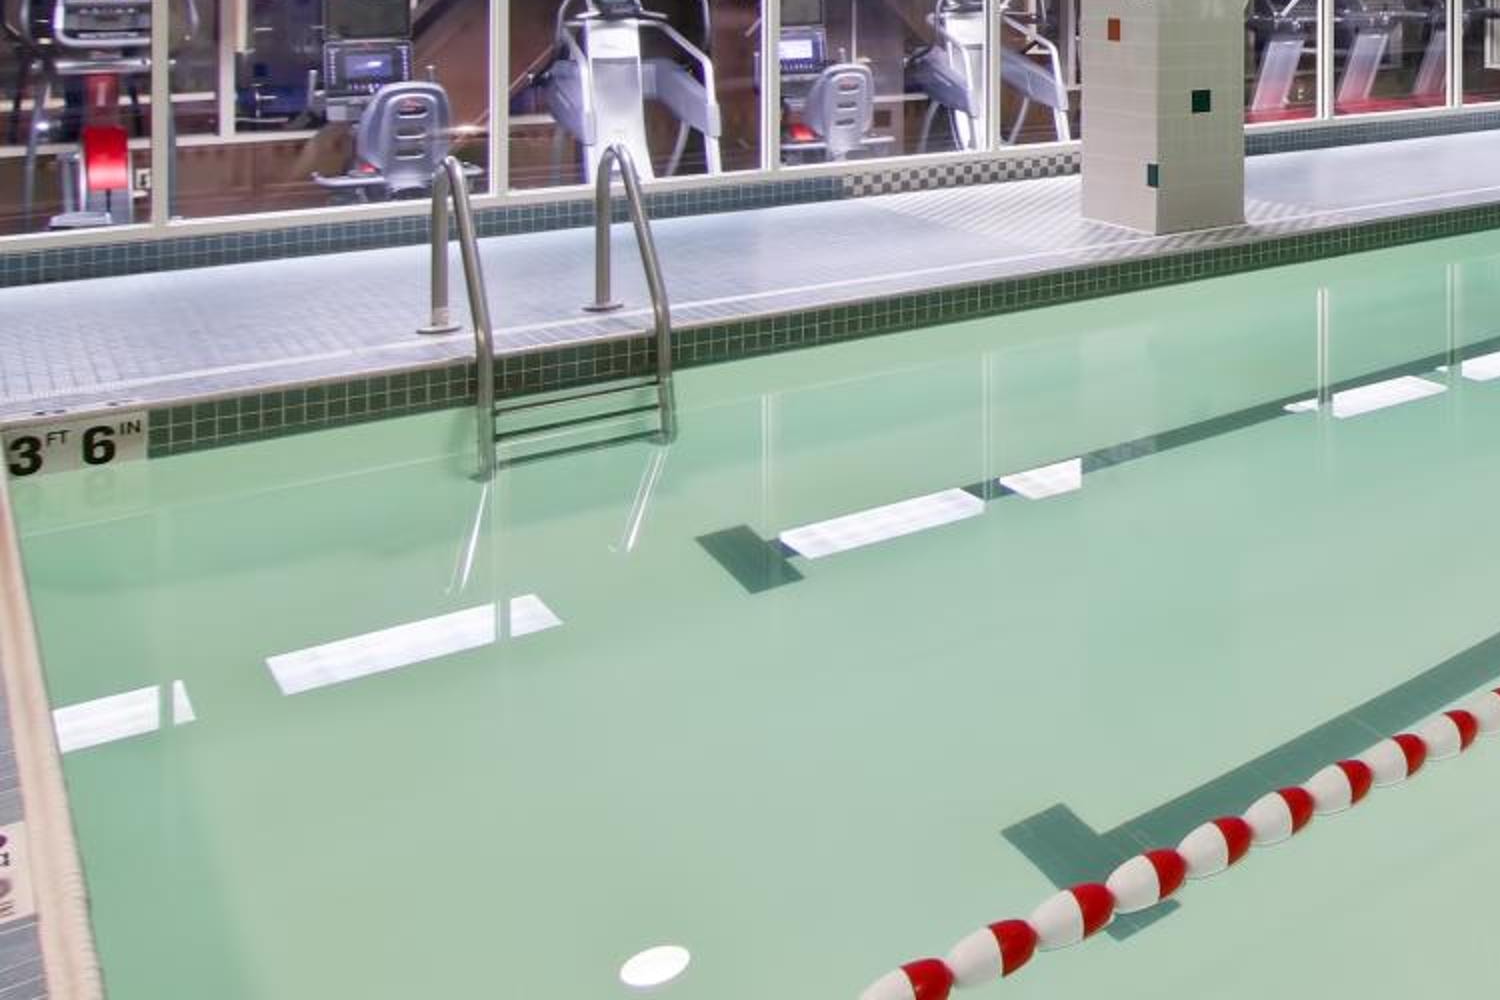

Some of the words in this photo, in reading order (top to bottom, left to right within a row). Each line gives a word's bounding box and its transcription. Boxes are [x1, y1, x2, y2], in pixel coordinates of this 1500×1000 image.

[8, 435, 43, 477] 3
[46, 429, 73, 447] FT
[82, 425, 116, 466] 6
[119, 419, 142, 435] IN
